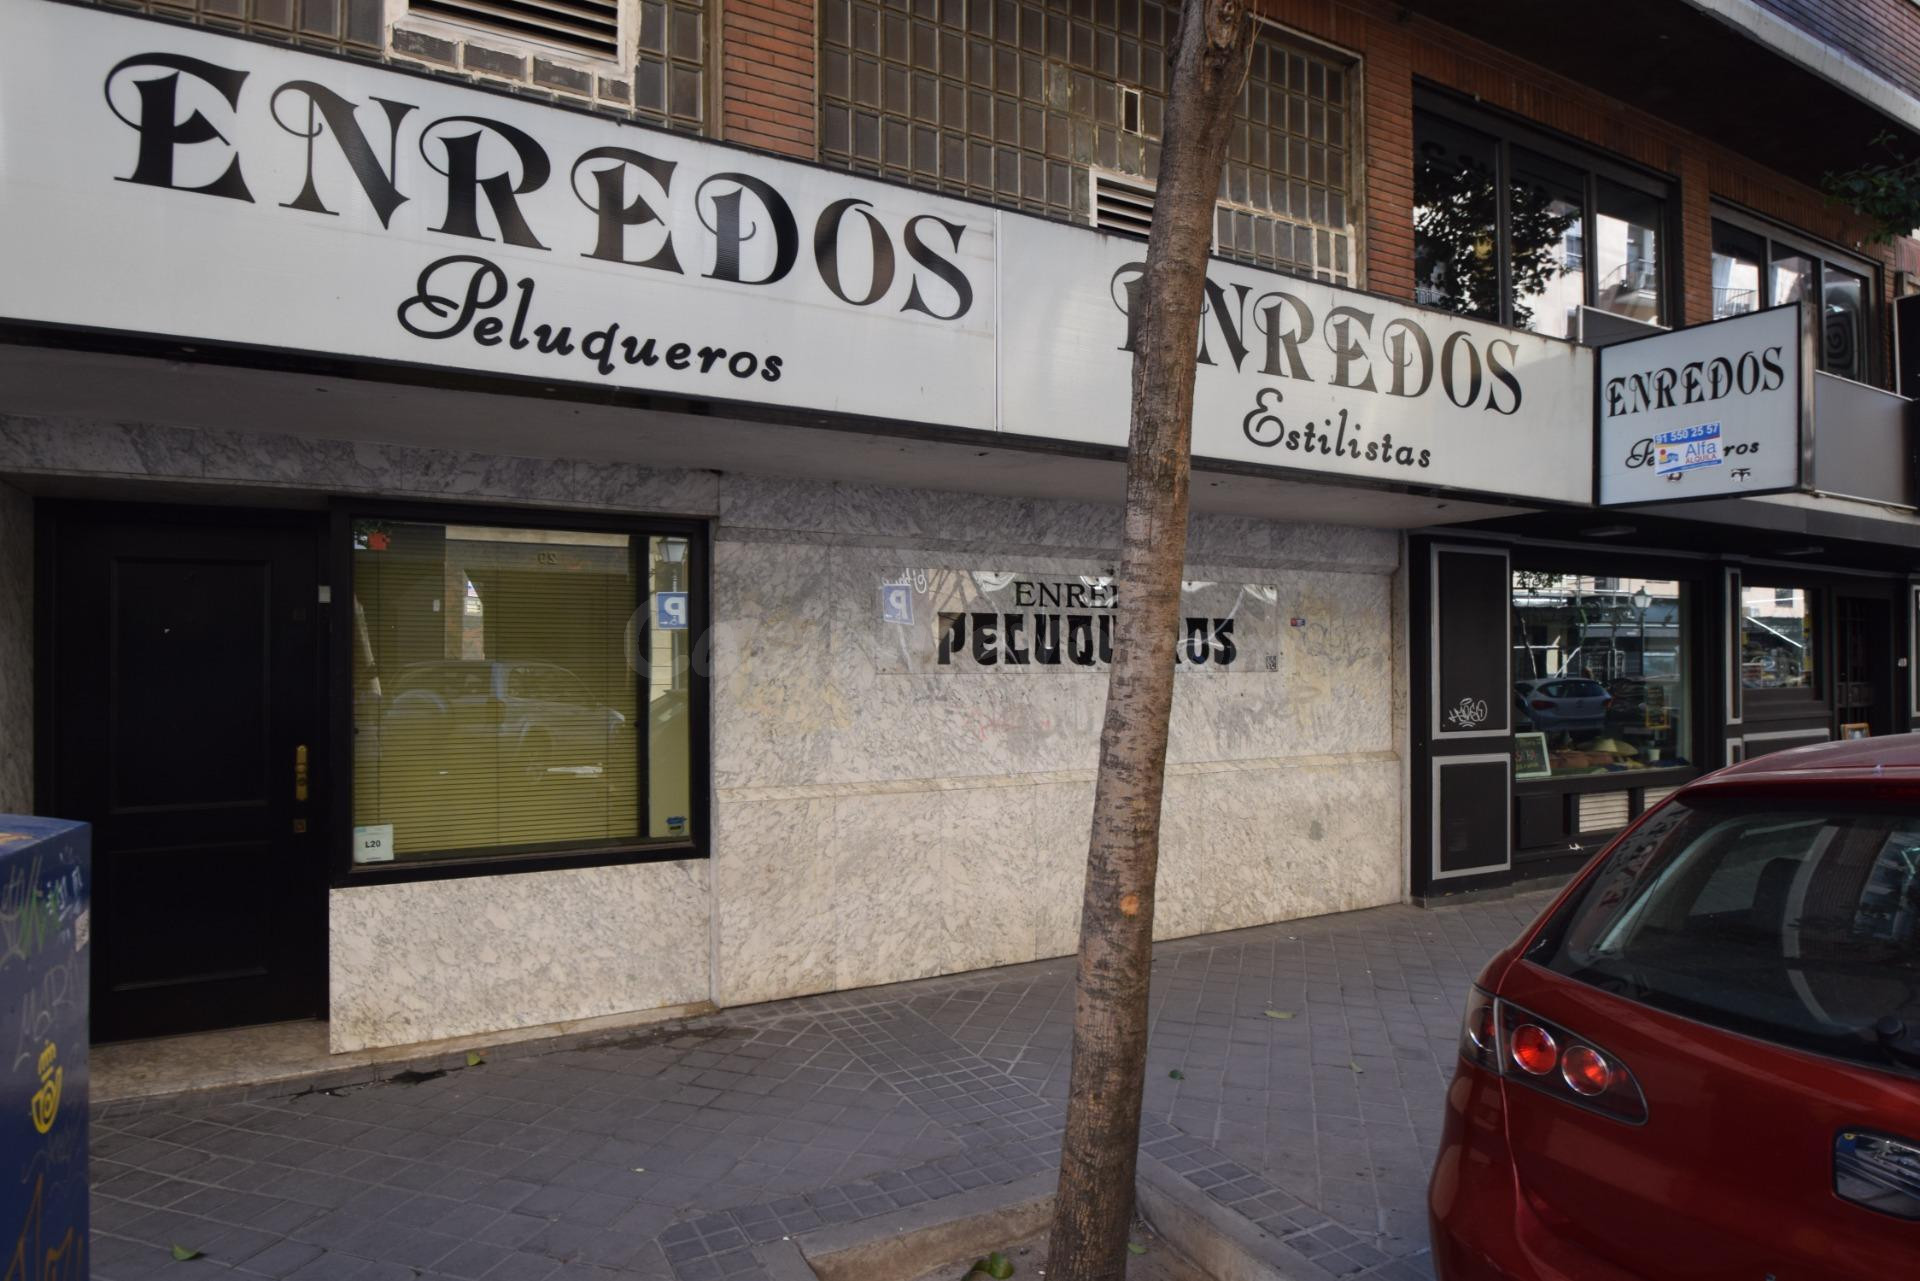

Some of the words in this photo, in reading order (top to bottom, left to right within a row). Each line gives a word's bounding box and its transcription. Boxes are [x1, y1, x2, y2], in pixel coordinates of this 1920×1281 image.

[104, 52, 974, 320] ENREDOS
[397, 255, 783, 382] Peluqueros
[1606, 346, 1784, 418] ENREDOS
[1243, 387, 1431, 468] Estilistas
[1687, 441, 1716, 456] Alfa
[1691, 426, 1704, 437] 25
[1707, 423, 1719, 434] 57
[1686, 454, 1717, 465] ALQUILA
[364, 839, 381, 848] L20
